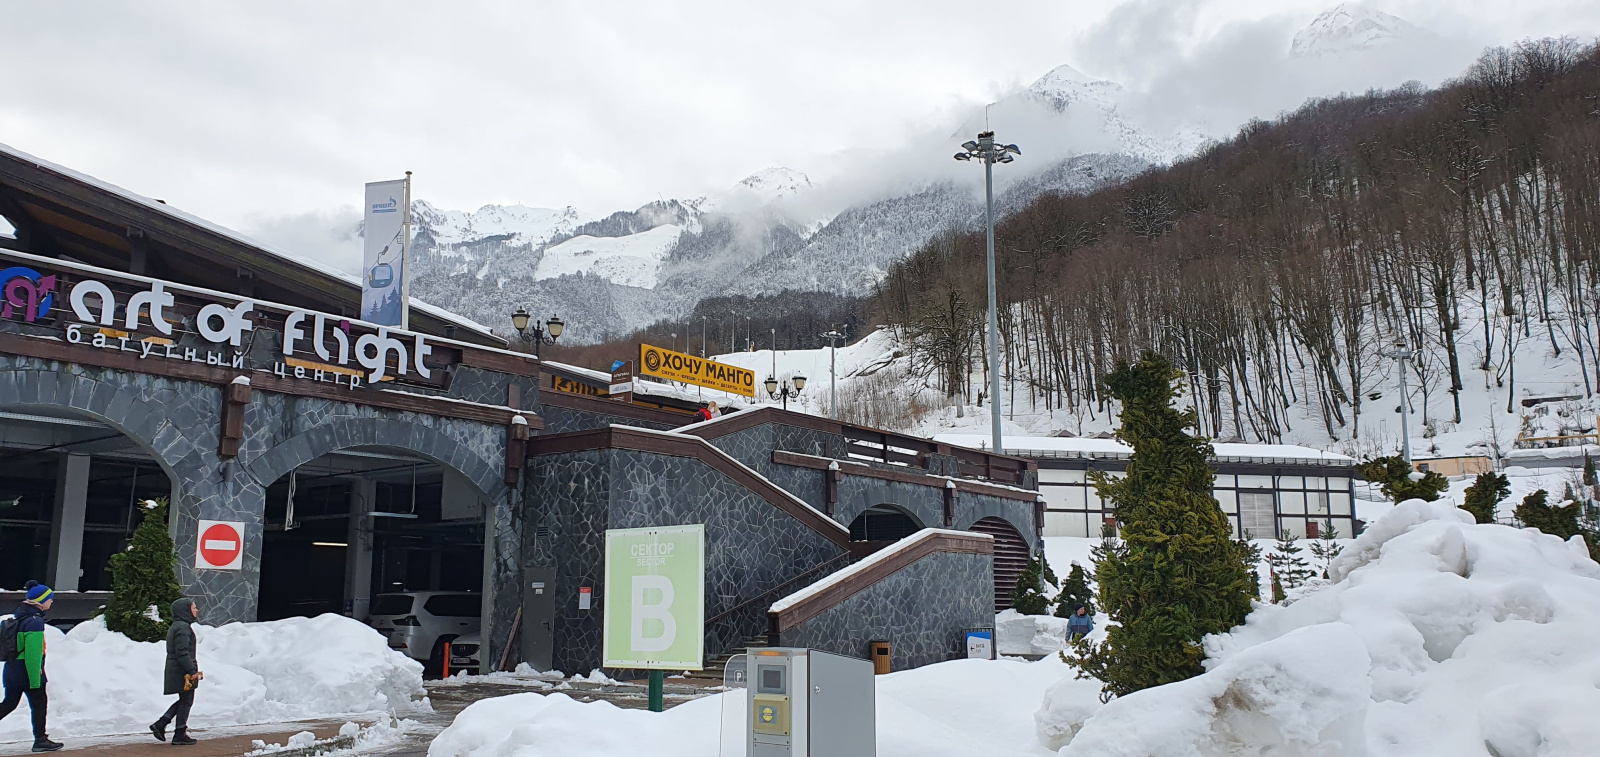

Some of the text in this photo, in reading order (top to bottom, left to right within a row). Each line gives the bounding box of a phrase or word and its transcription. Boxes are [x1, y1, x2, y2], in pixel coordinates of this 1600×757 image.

[70, 280, 432, 383] art of flight
[66, 324, 361, 390] батутный центр
[662, 352, 753, 386] ХОЧУ МАНГО
[631, 543, 675, 556] СЕКТОР
[637, 558, 666, 566] SECTOR
[631, 575, 677, 651] B
